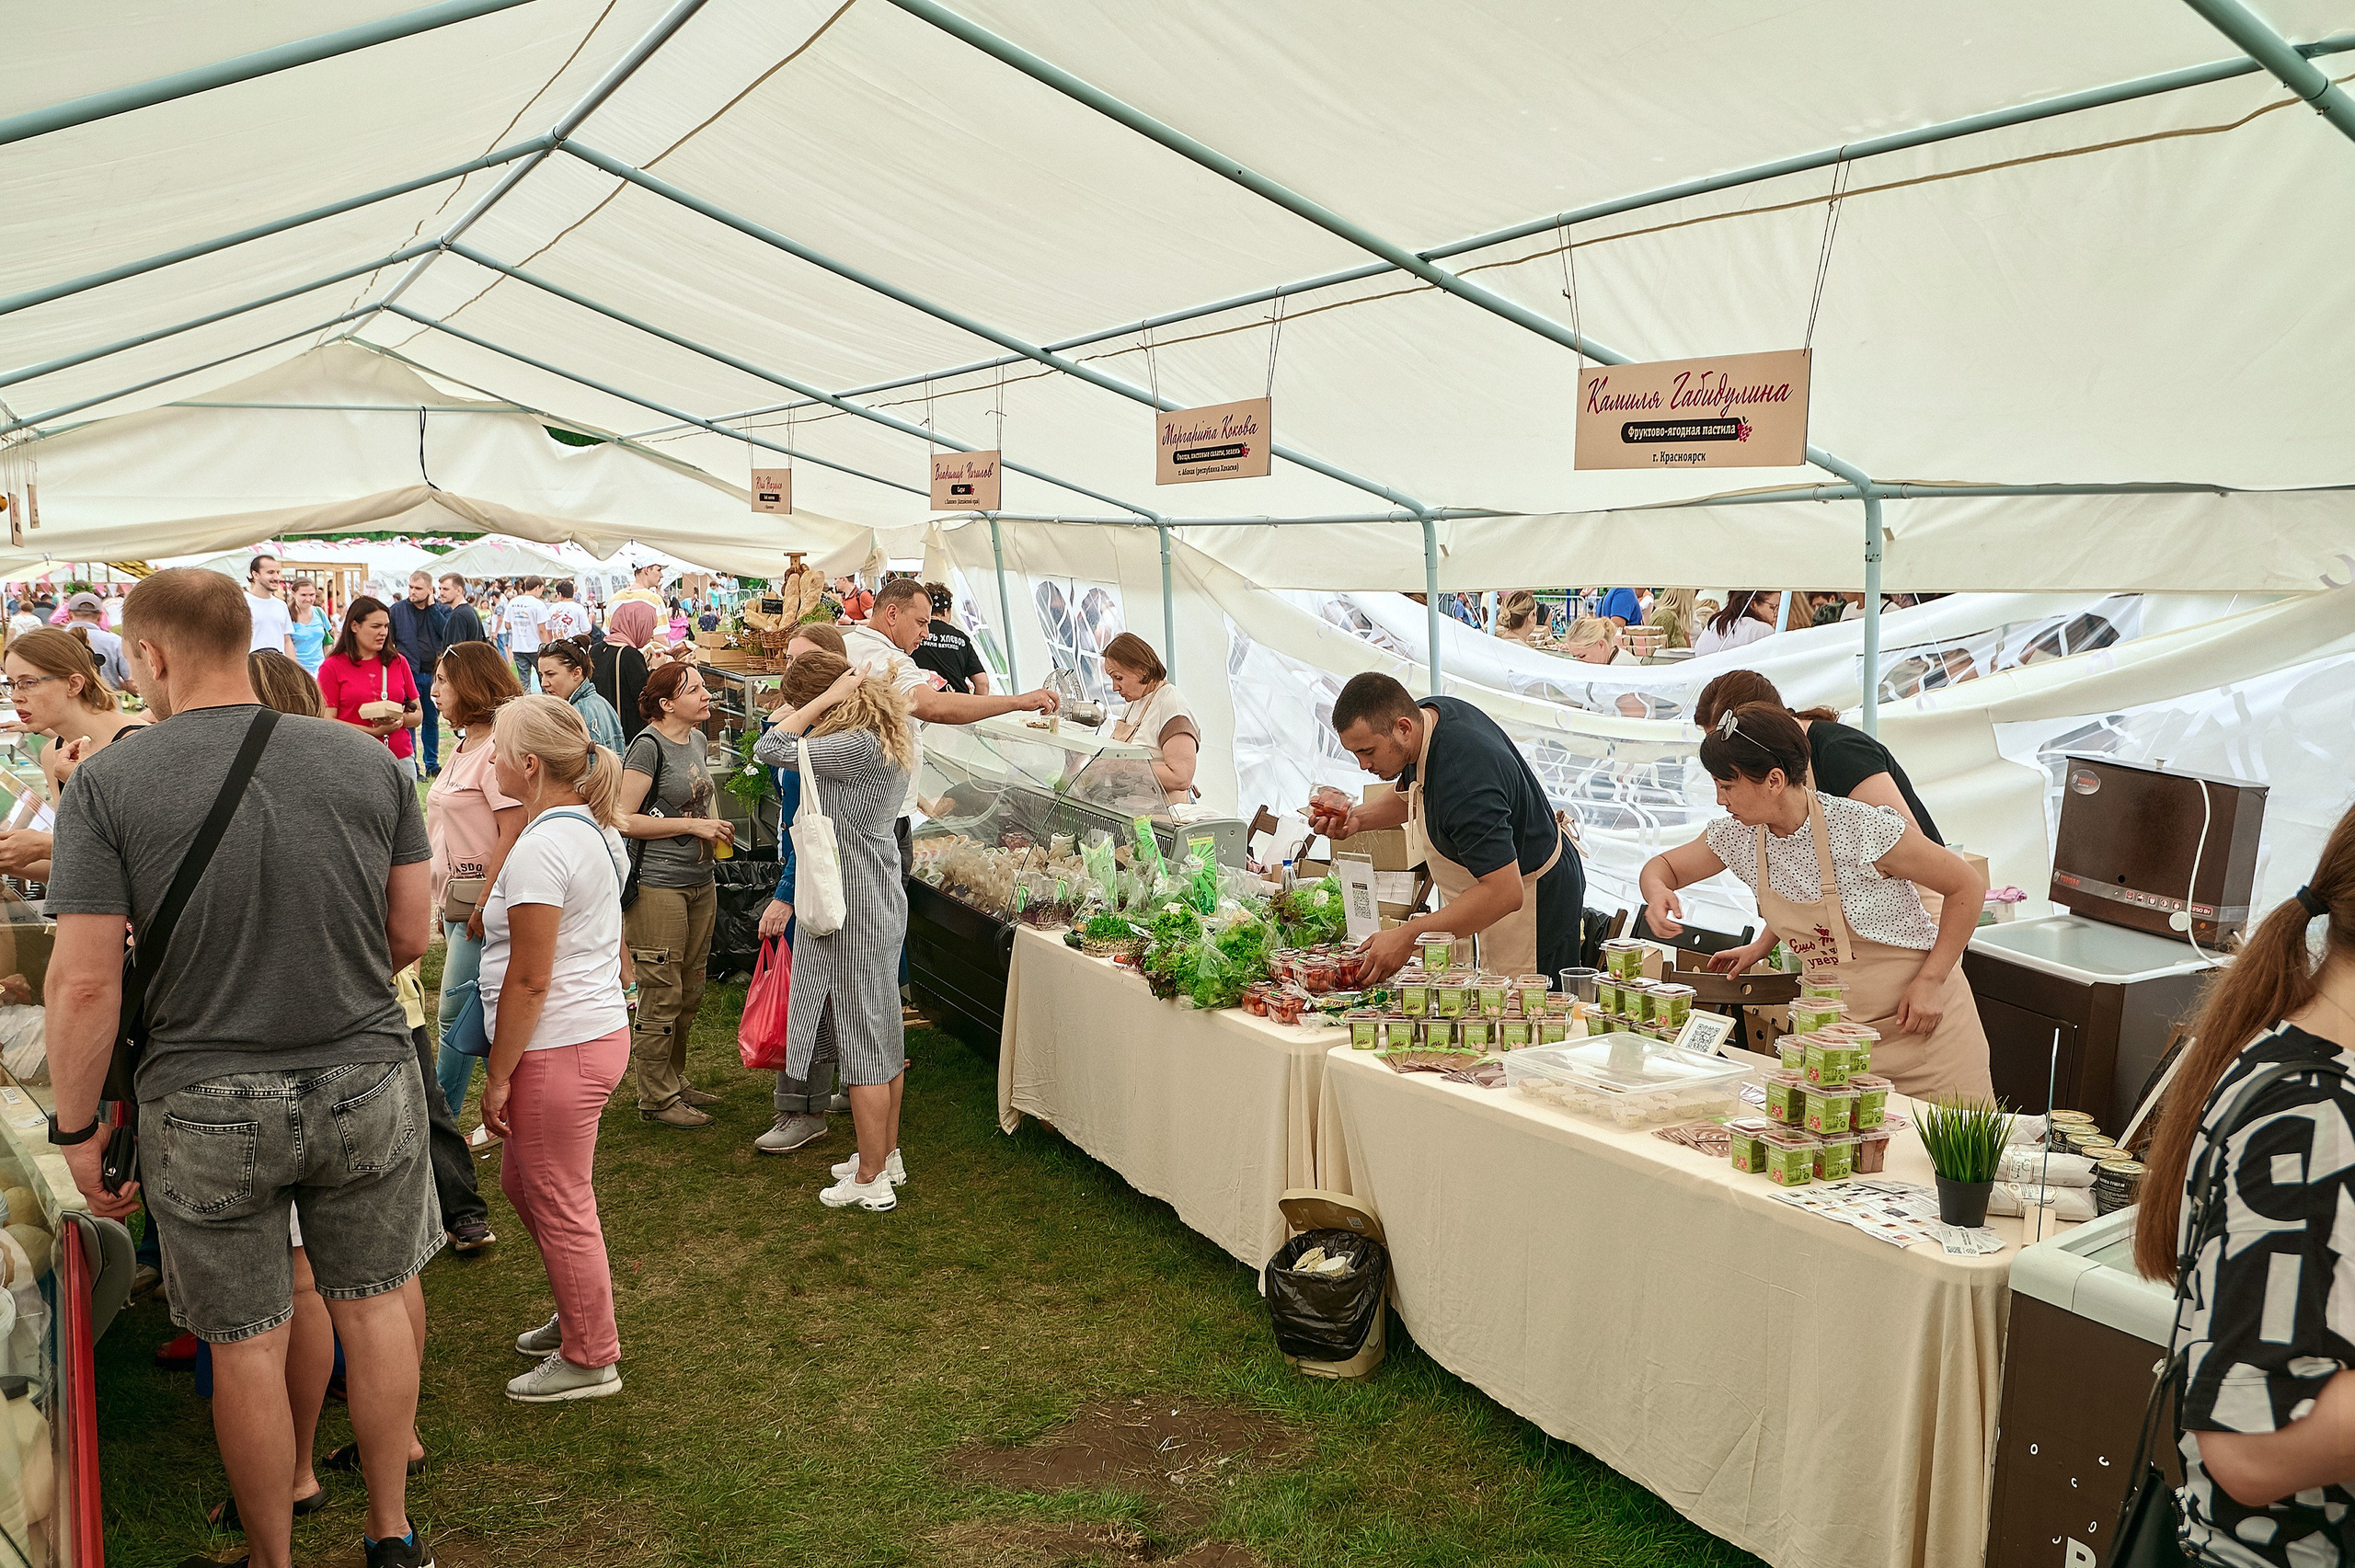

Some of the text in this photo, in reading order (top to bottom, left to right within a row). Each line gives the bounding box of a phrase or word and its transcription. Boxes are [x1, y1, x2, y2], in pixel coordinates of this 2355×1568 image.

[1586, 370, 1795, 418] Камиля Габидулина
[1162, 414, 1259, 451] Маргарита Кокова
[1627, 424, 1736, 441] Фруктово-ягодная пастила
[1652, 451, 1706, 464] г. Красноярск
[1788, 938, 1816, 954] Ешь
